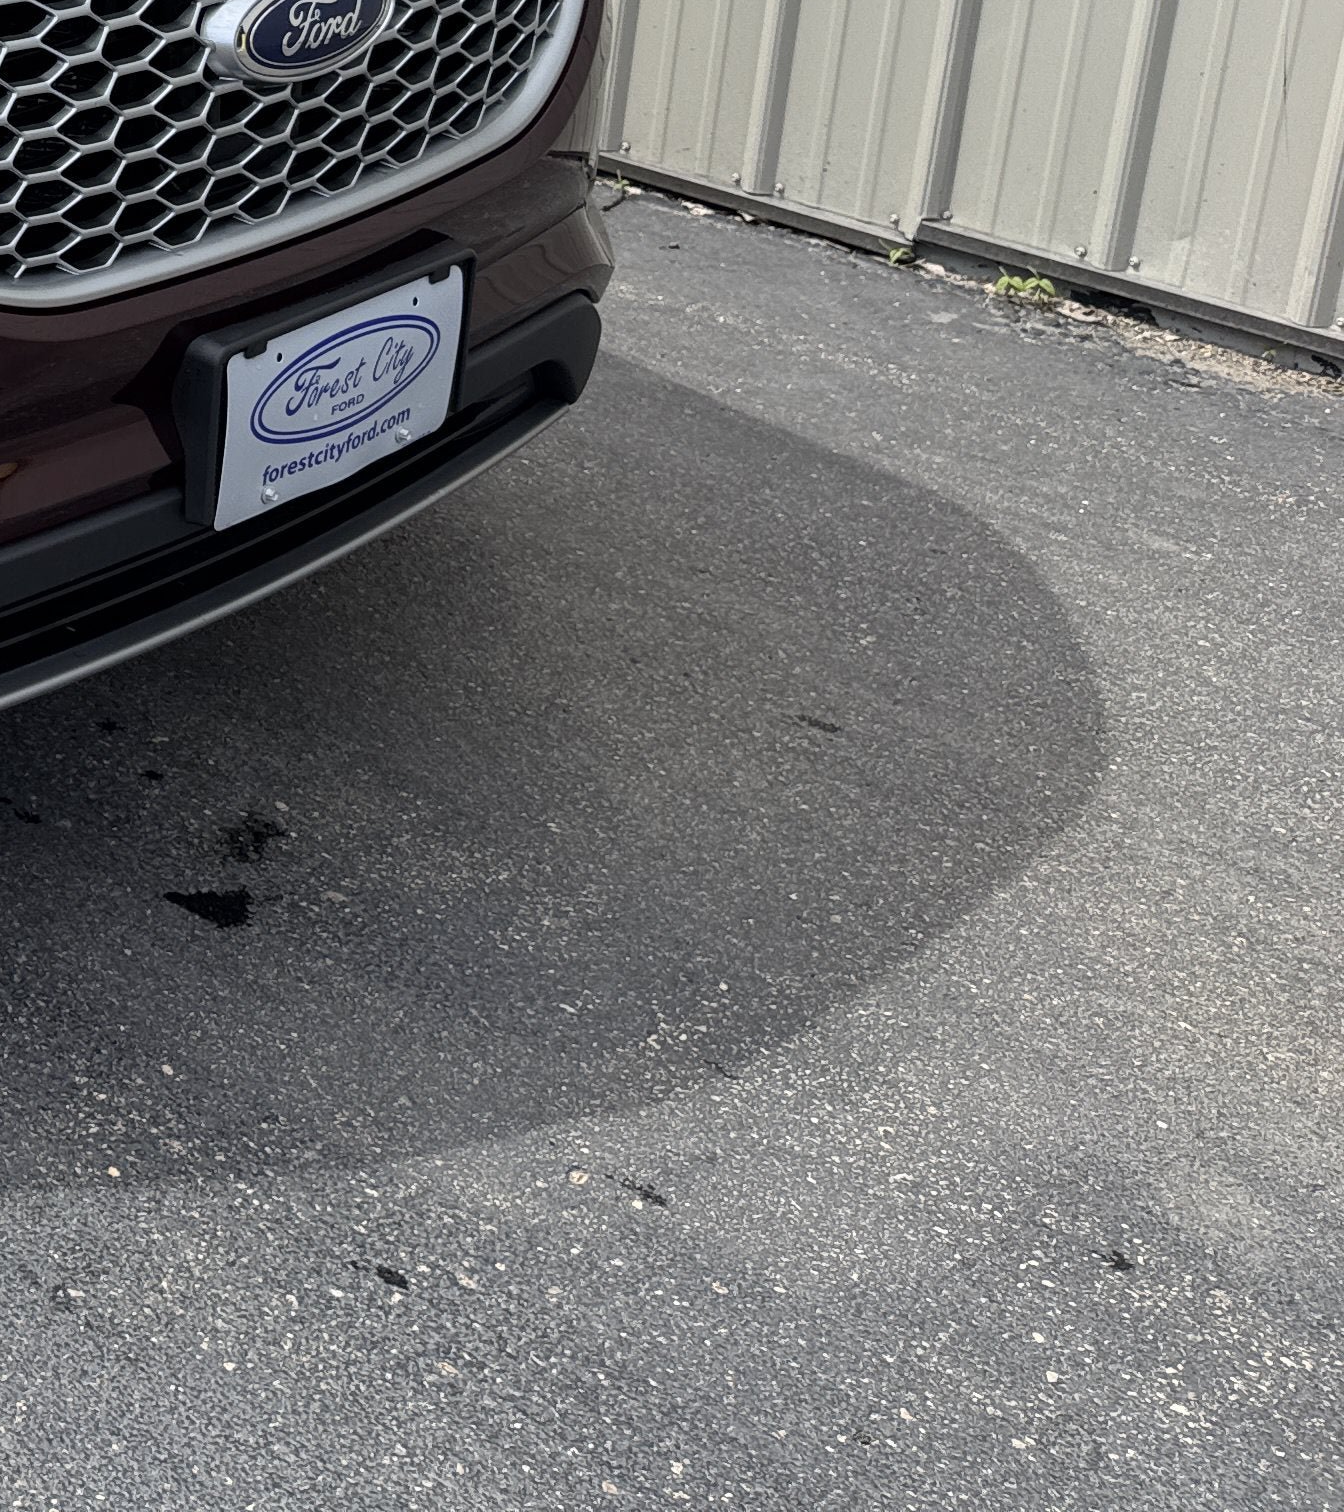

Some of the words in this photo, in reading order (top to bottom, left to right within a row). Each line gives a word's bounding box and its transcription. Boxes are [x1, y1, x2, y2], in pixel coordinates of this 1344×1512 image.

[285, 356, 367, 417] Forest
[372, 336, 414, 385] City
[330, 393, 365, 416] FORD
[262, 407, 411, 486] forestcityford.com
